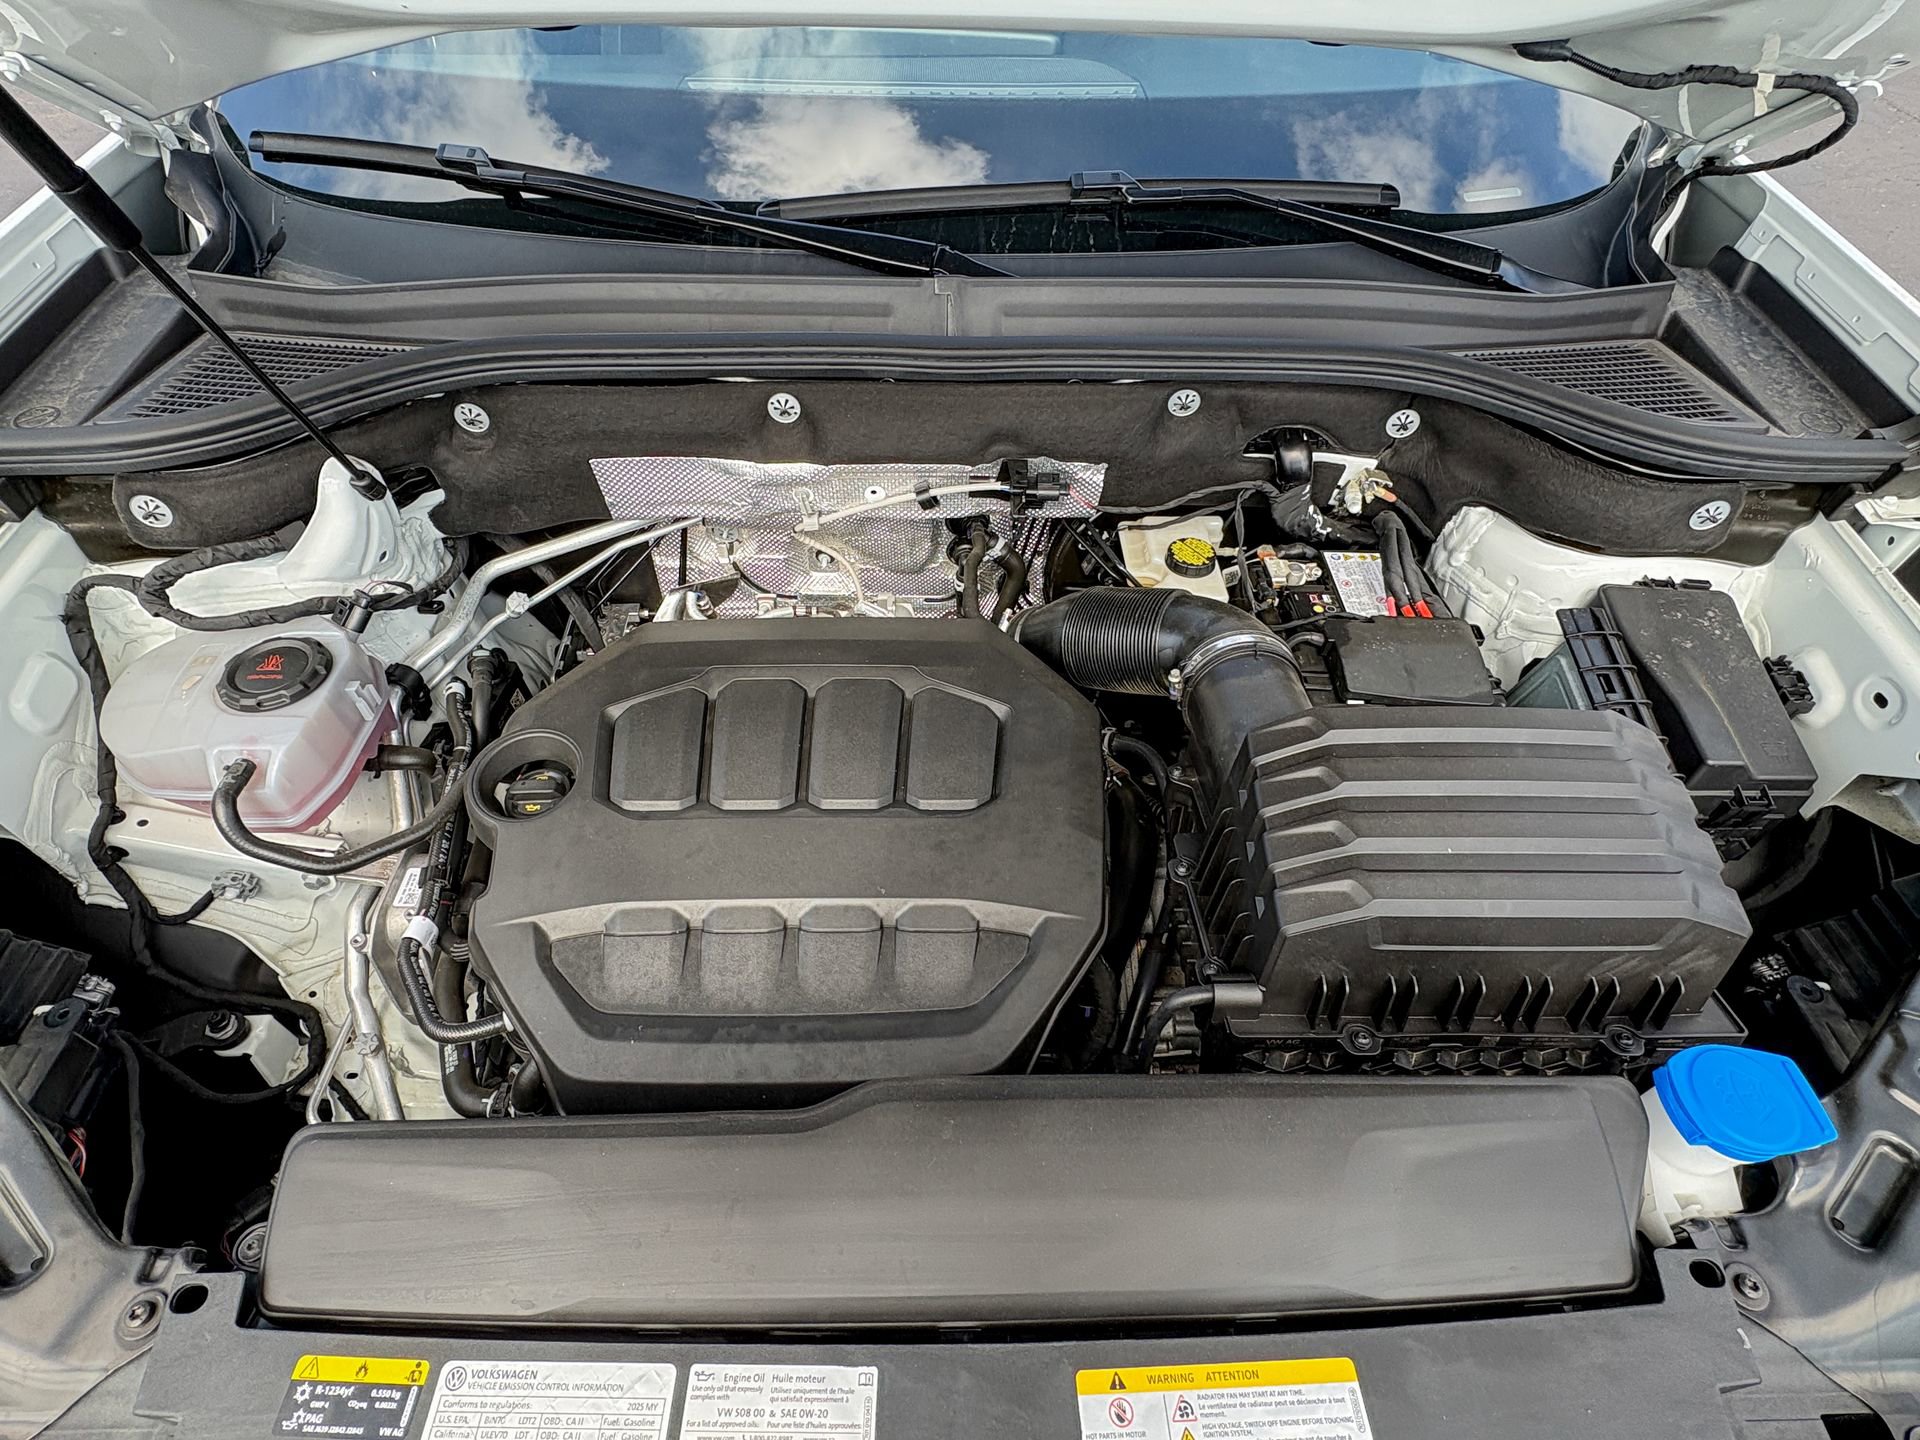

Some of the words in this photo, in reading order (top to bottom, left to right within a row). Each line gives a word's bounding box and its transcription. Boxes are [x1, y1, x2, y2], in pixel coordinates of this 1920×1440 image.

[471, 1368, 538, 1380] VOLKSWAGEN
[724, 1373, 751, 1384] Engine
[753, 1373, 765, 1383] Oil
[772, 1373, 794, 1383] Huile
[795, 1374, 826, 1383] moteur
[1146, 1372, 1194, 1384] WARNING
[1206, 1369, 1260, 1382] ATTENTION
[468, 1381, 497, 1390] VEHICLE
[498, 1382, 534, 1391] EMISSION
[536, 1382, 570, 1391] CONTROL
[572, 1383, 624, 1392] INFORMATION
[314, 1385, 354, 1398] R-1234yf
[392, 1390, 401, 1400] kg
[690, 1394, 715, 1402] complies
[804, 1396, 844, 1404] expressément
[443, 1400, 478, 1409] Conforms
[480, 1400, 487, 1408] to
[489, 1400, 532, 1411] regulations:
[627, 1402, 644, 1411] 2025
[645, 1403, 659, 1411] MY
[717, 1408, 733, 1417] VW
[735, 1408, 751, 1417] 508
[753, 1408, 765, 1418] 00
[780, 1409, 797, 1418] SAE
[799, 1409, 828, 1418] 0W-20
[304, 1414, 324, 1424] PAG
[518, 1417, 536, 1425] LDT2
[566, 1417, 576, 1426] CA
[603, 1418, 620, 1426] Fuel:
[624, 1418, 655, 1427] Gasoline
[379, 1427, 393, 1436] VW
[392, 1428, 404, 1436] AG
[434, 1430, 471, 1439] California:
[481, 1431, 508, 1439] ULEV70
[515, 1431, 530, 1440] LDT
[562, 1432, 573, 1440] CA
[621, 1432, 653, 1440] Gasoline
